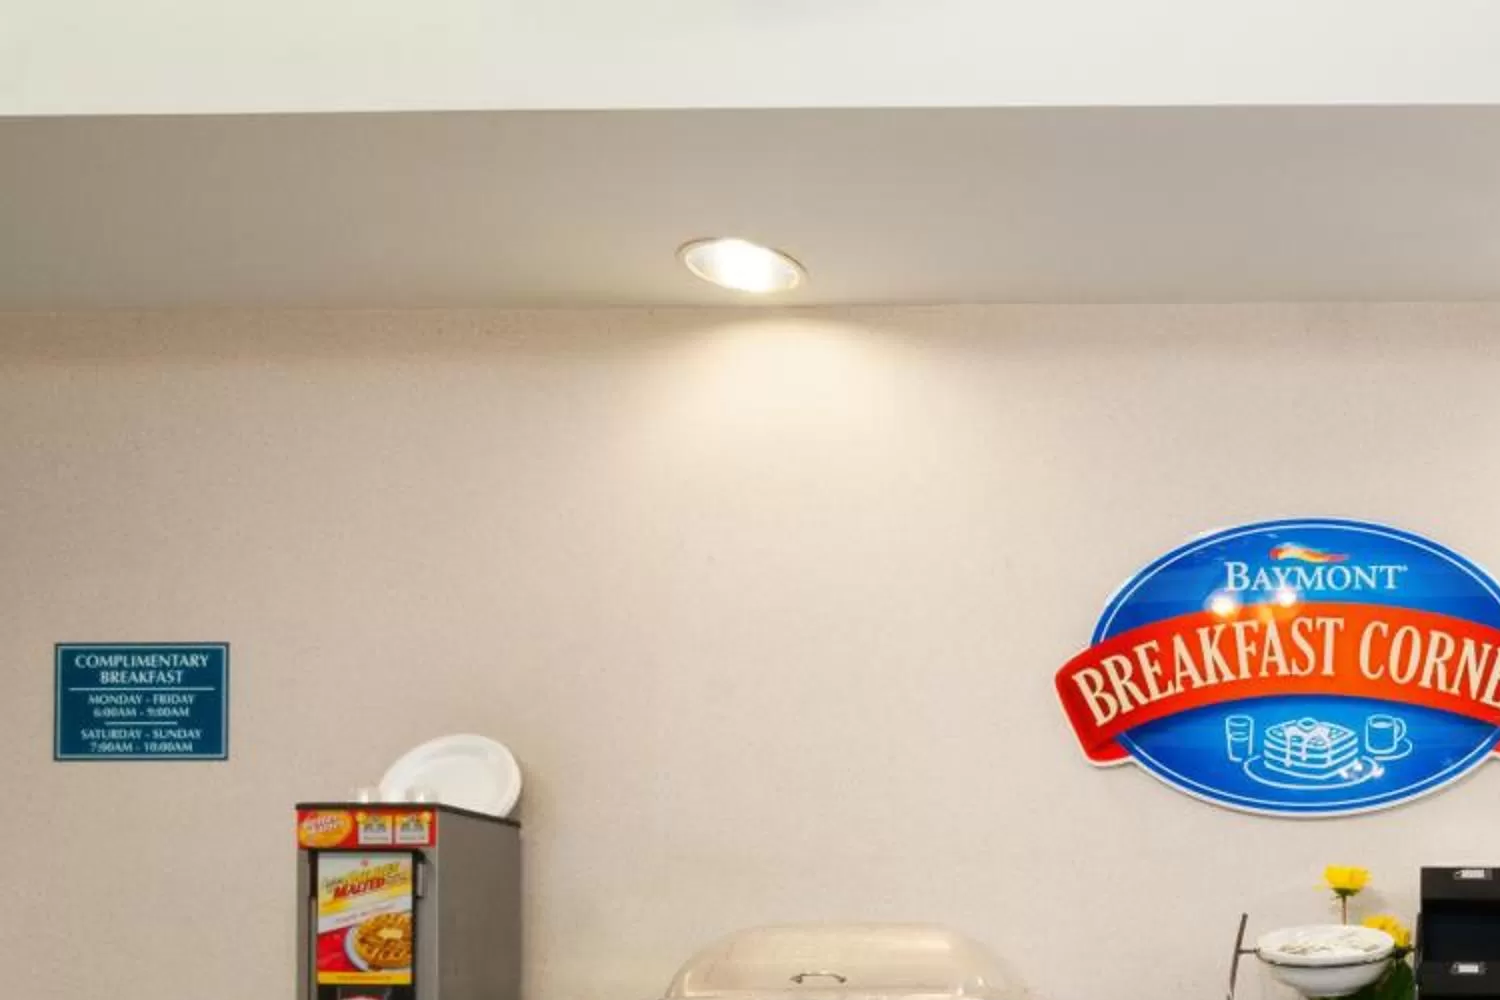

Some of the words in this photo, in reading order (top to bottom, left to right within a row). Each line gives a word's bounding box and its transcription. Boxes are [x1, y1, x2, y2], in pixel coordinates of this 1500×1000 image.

[1224, 560, 1400, 593] BAYMONT
[74, 653, 210, 669] COMPLIMENTARY
[99, 670, 184, 685] BREAKFAST
[1072, 616, 1345, 728] BREAKFAST
[88, 693, 143, 705] MONDAY
[153, 693, 196, 705] FRIDAY
[80, 728, 143, 740] SATURDAY
[152, 728, 203, 739] SUNDAY
